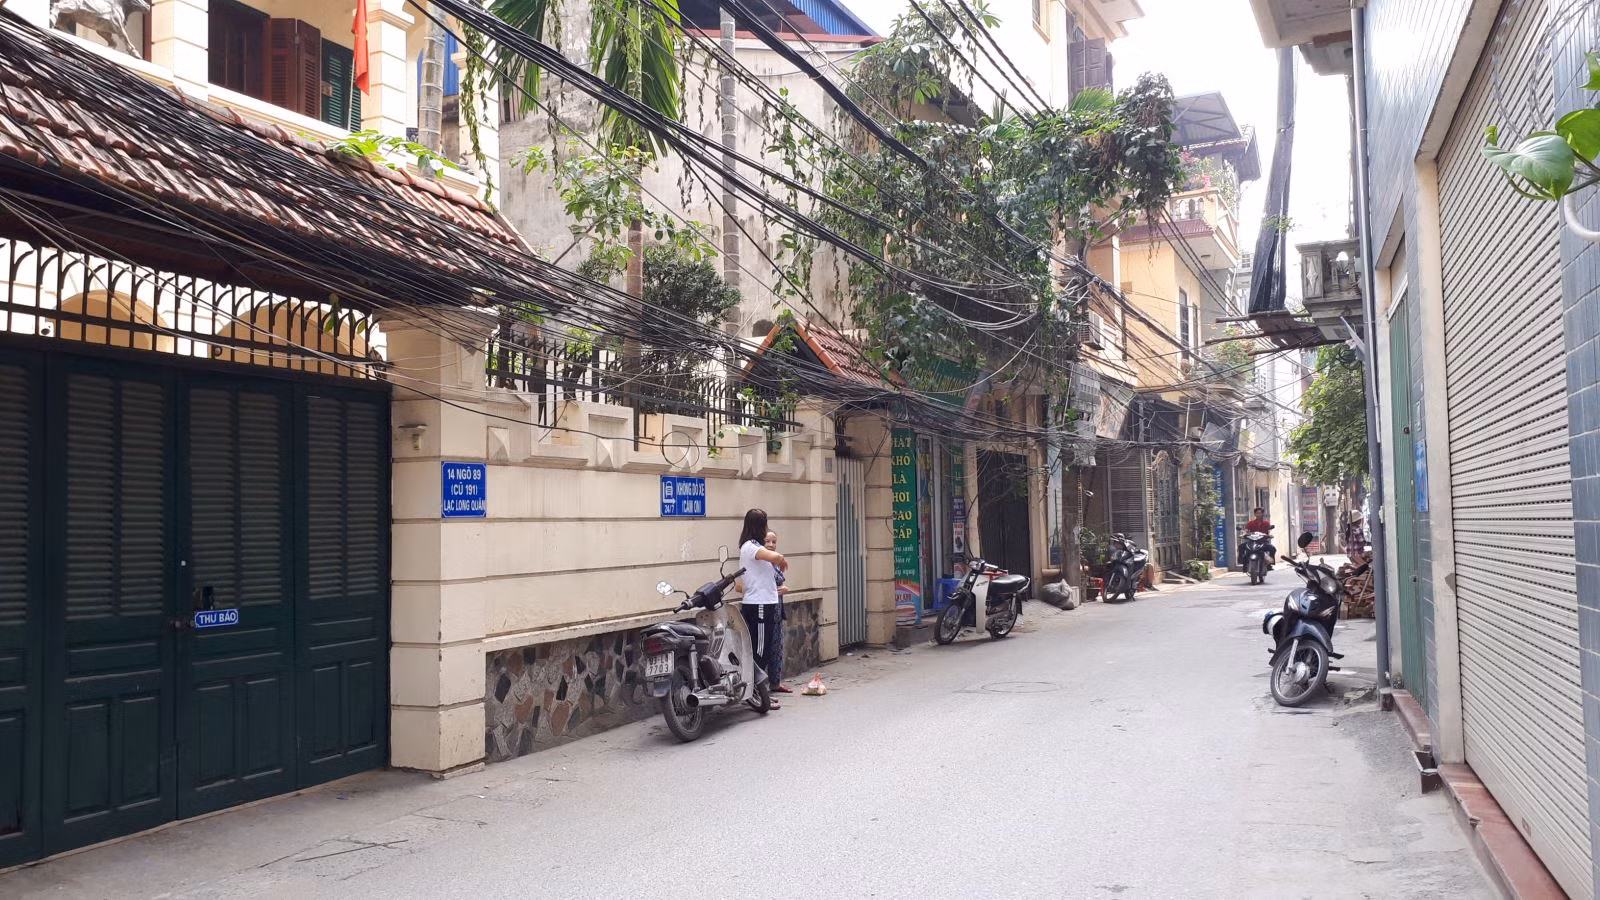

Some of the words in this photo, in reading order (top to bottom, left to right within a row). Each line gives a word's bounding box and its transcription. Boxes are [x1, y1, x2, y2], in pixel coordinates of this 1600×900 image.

[447, 468, 455, 480] 14
[456, 466, 472, 480] NGÕ
[472, 469, 482, 480] 89
[699, 482, 705, 497] XE
[444, 499, 455, 513] LẠC
[455, 499, 470, 511] LONG
[664, 504, 674, 514] 24/7
